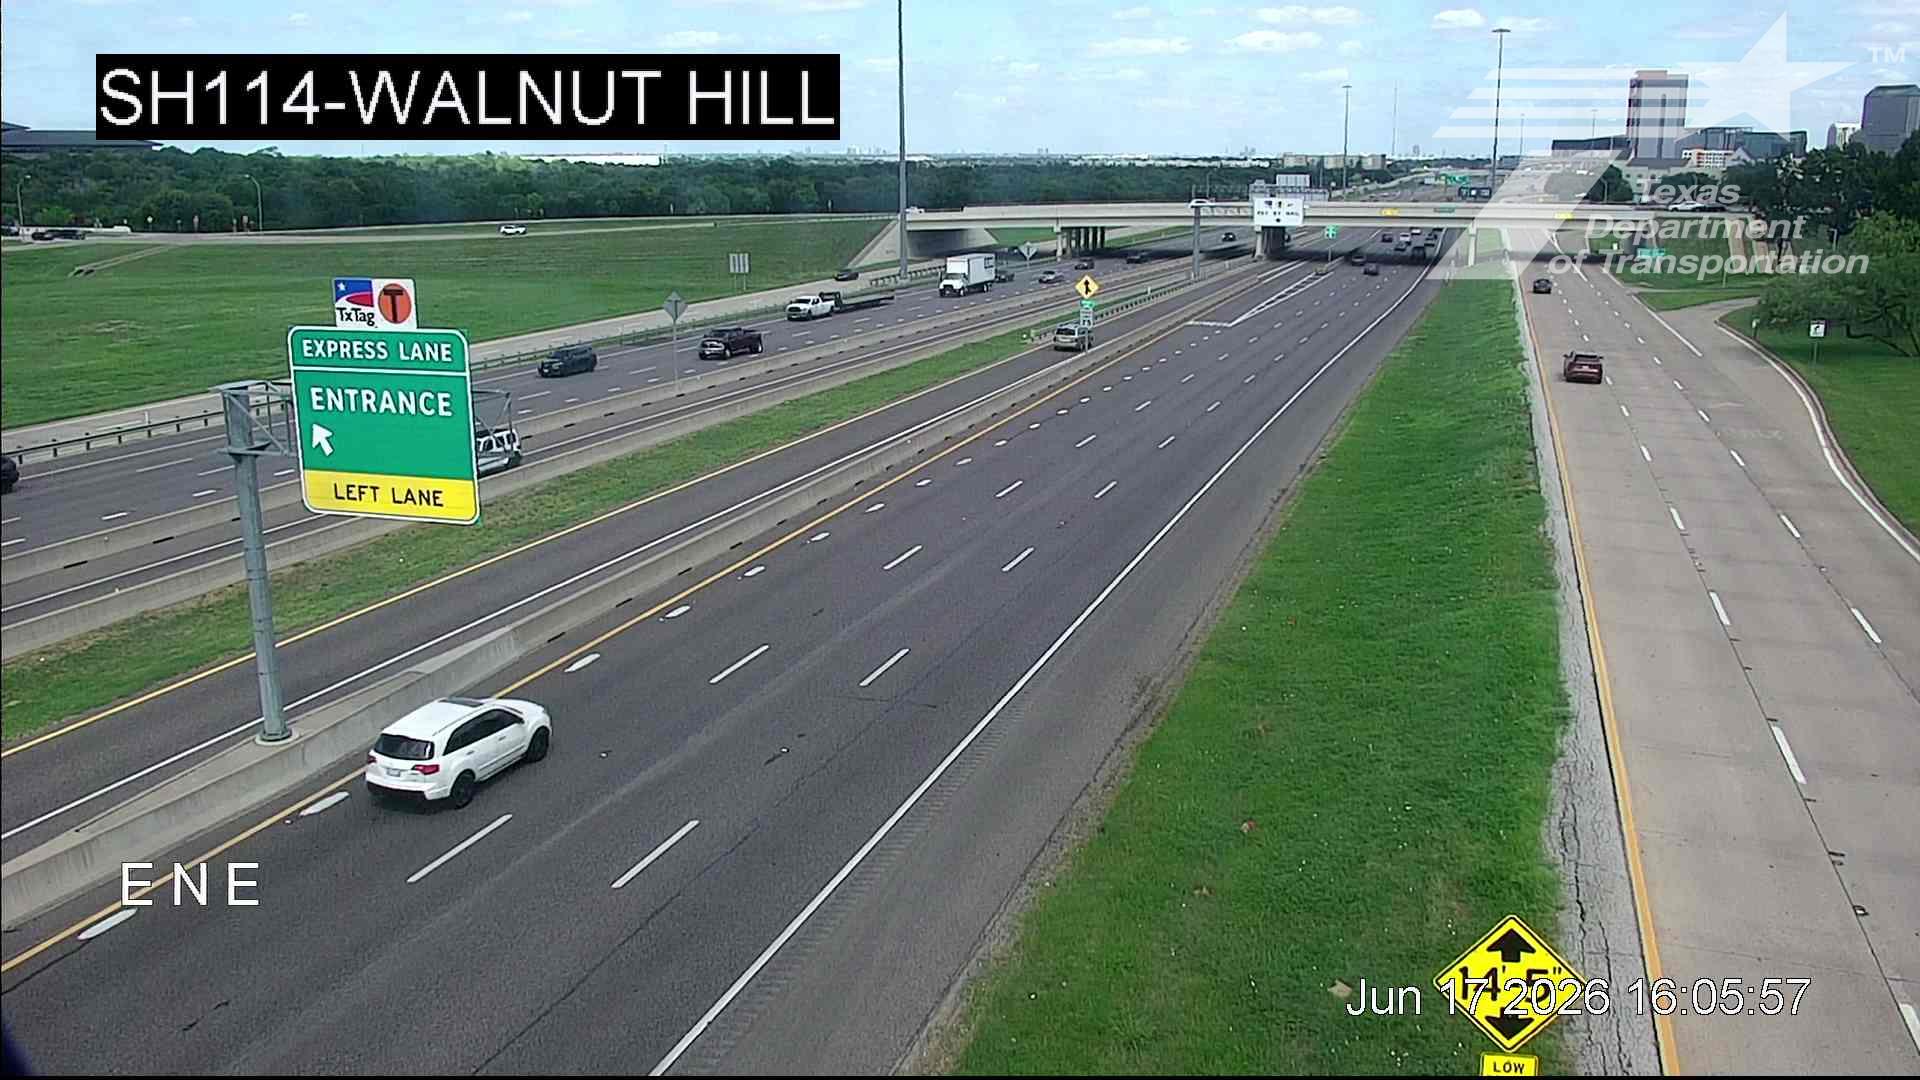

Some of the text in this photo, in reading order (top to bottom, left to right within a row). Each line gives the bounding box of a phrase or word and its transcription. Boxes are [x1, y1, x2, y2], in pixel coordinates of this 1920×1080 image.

[336, 307, 376, 327] TxTag
[302, 339, 453, 362] EXPRESS LANE
[310, 387, 453, 417] ENTRANCE
[334, 483, 444, 507] LEFT LANE
[1493, 1061, 1525, 1073] LOW
